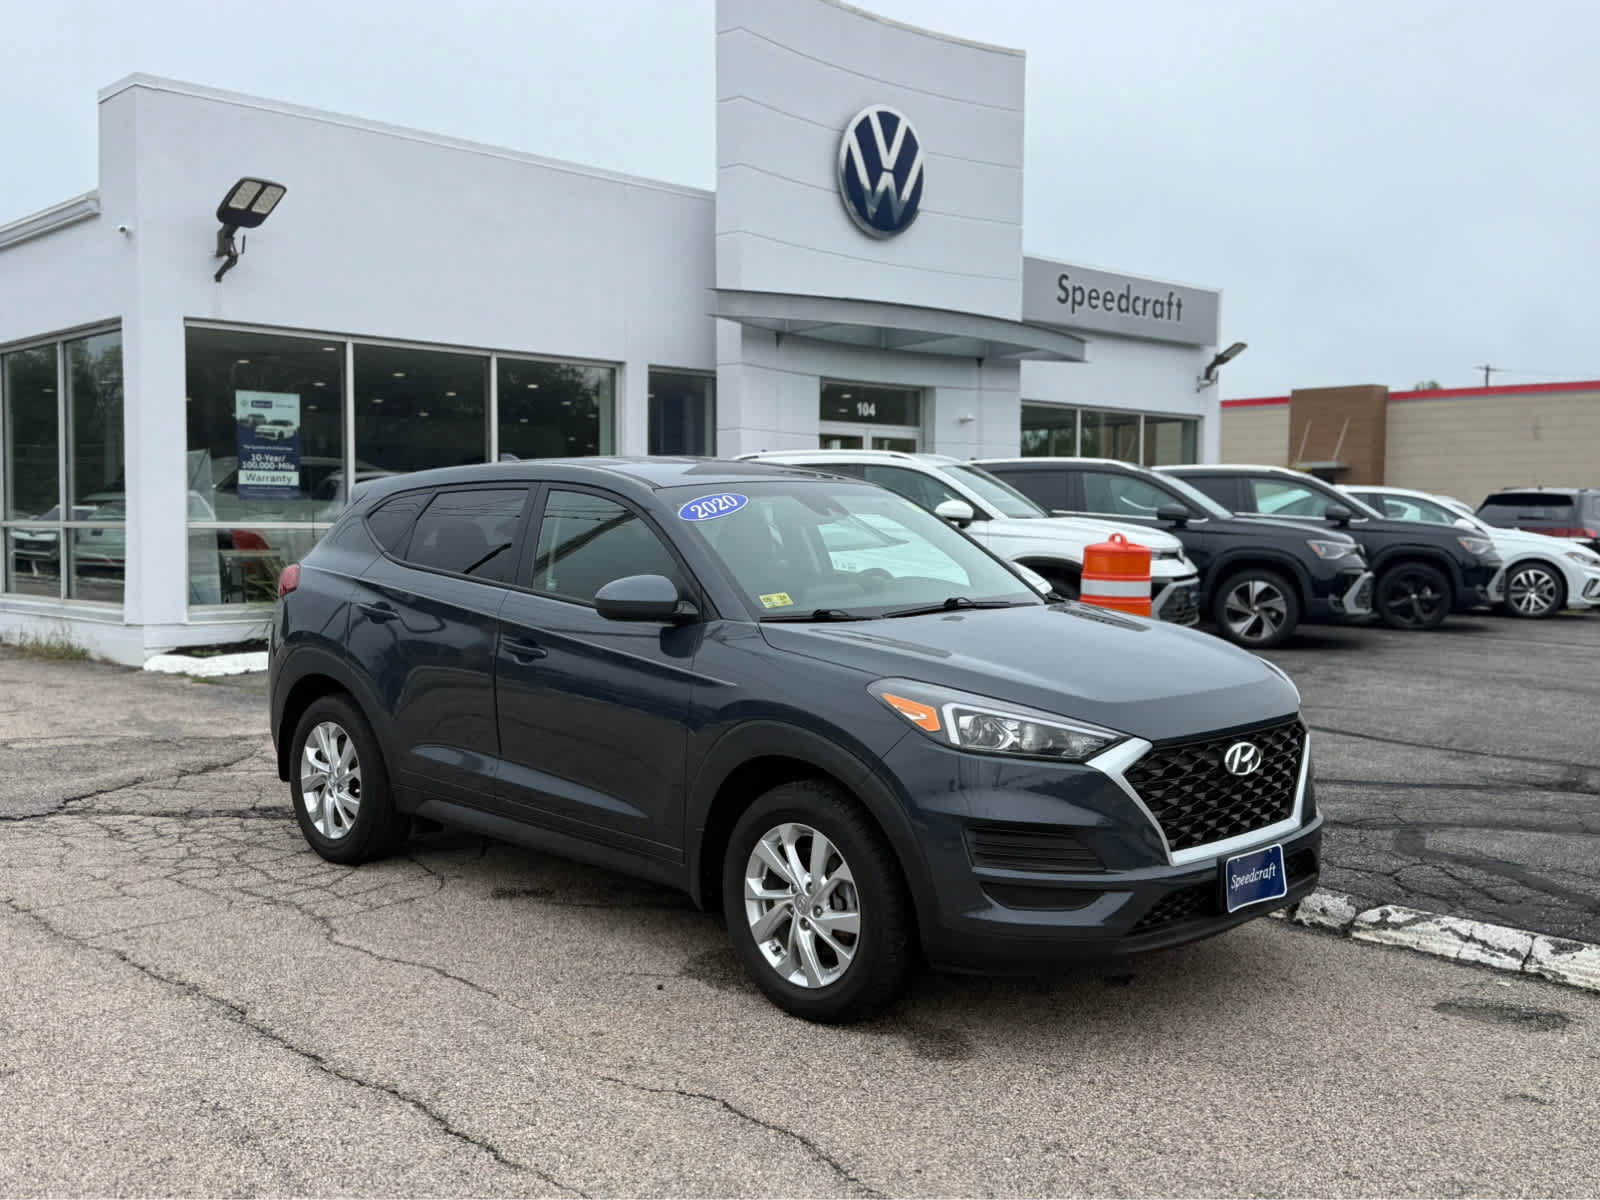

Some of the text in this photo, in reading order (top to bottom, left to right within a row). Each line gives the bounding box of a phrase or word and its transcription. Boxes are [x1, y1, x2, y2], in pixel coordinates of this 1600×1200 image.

[1057, 273, 1183, 322] Speedcraft
[857, 402, 876, 416] 104
[245, 473, 293, 484] Warranty
[690, 494, 738, 518] 2020
[1231, 862, 1276, 891] Speedcraft
